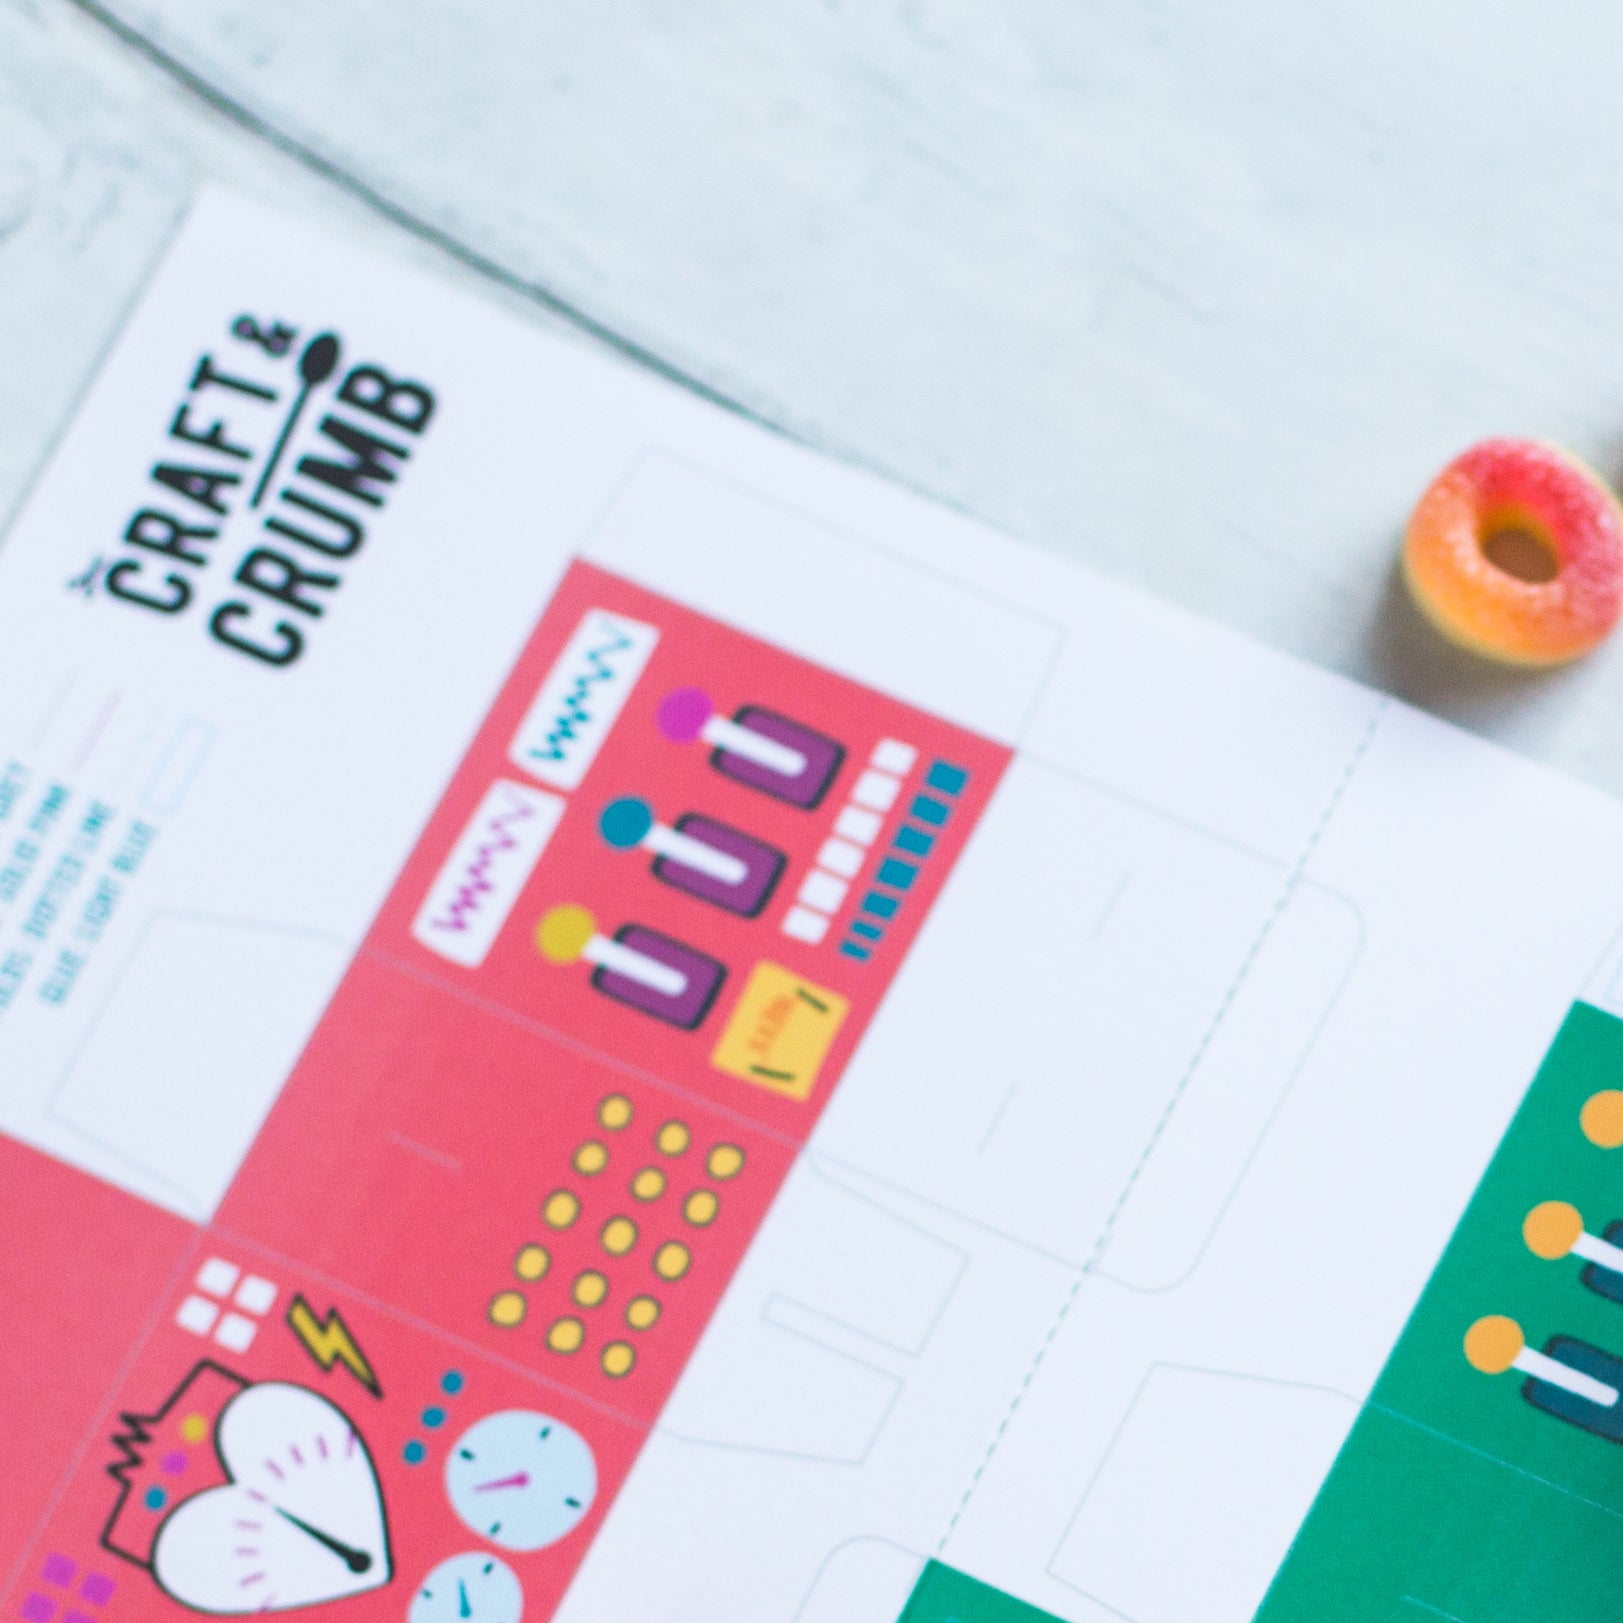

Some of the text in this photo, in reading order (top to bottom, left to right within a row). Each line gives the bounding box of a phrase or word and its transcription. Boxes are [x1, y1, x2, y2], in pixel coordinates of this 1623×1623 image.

[104, 313, 298, 616] CRAFT &
[208, 364, 440, 668] CRUMB
